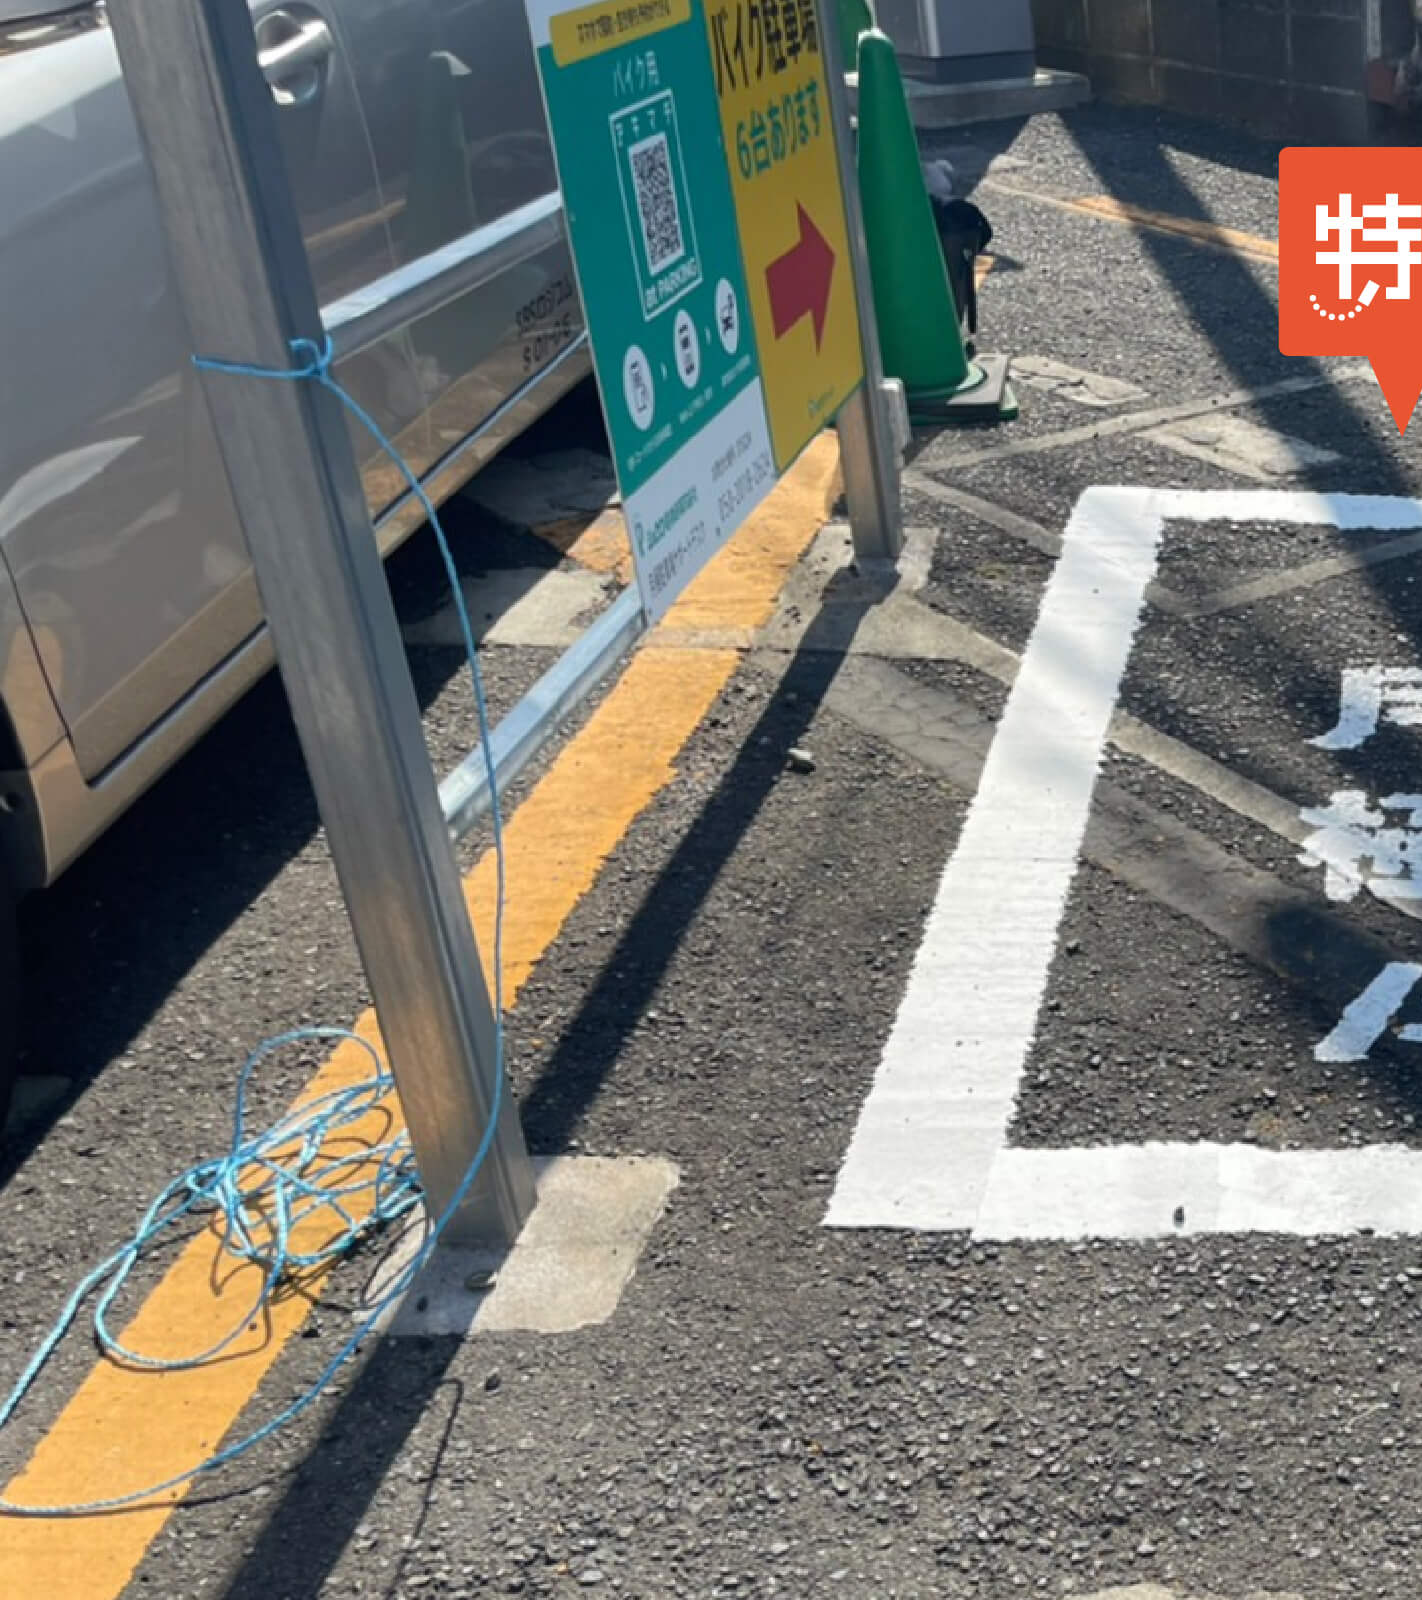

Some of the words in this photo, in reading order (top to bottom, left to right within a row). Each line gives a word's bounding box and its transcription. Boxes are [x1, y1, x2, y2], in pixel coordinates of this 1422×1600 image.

[737, 77, 821, 180] 6台あります
